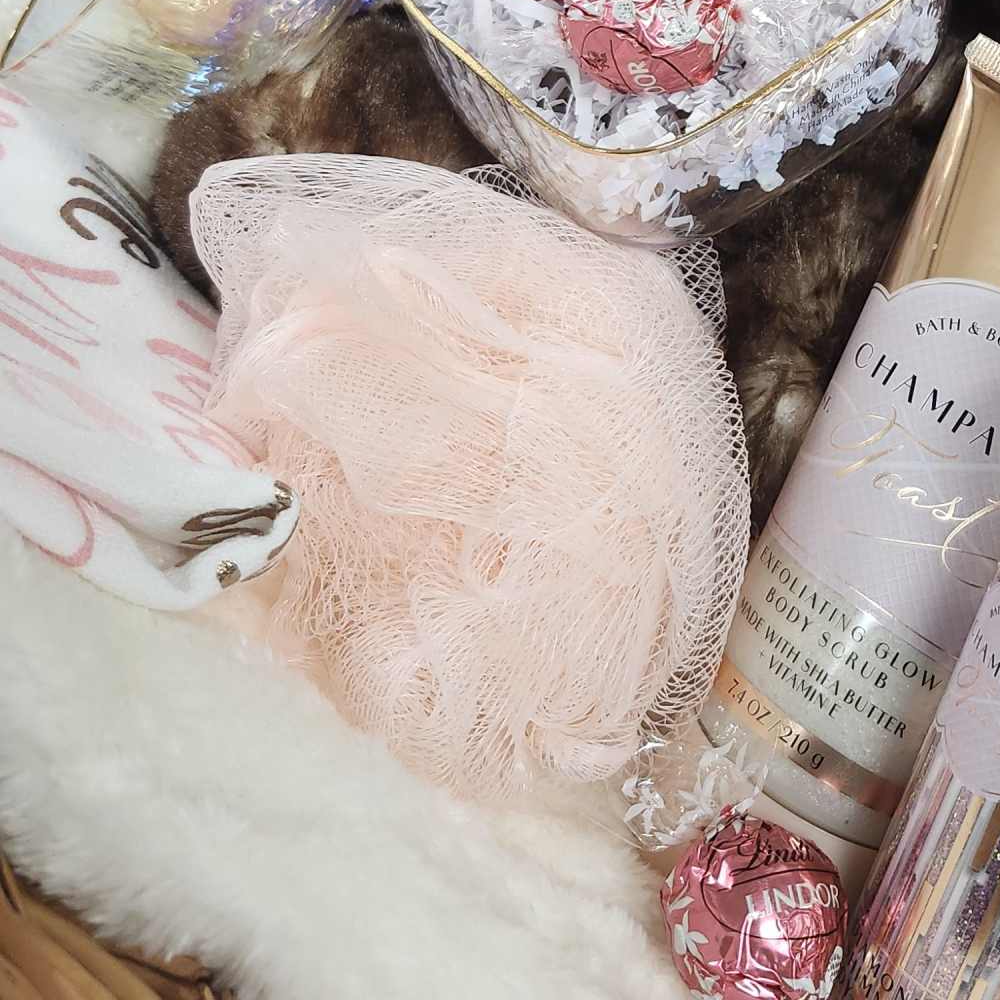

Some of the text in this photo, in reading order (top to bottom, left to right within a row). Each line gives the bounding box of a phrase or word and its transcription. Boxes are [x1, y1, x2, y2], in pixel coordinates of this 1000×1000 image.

[914, 317, 962, 336] BATH
[967, 321, 982, 336] &
[759, 544, 944, 692] EXFOLIATING GLOW
[764, 585, 889, 690] BODY SCRUB
[739, 597, 764, 632] MADE
[764, 624, 802, 664] WITH
[842, 688, 908, 739] BUTTER
[726, 679, 746, 704] 7.4
[747, 698, 773, 727] OZ
[778, 725, 811, 756] 210
[811, 753, 826, 771] g
[744, 881, 840, 920] LINDOR
